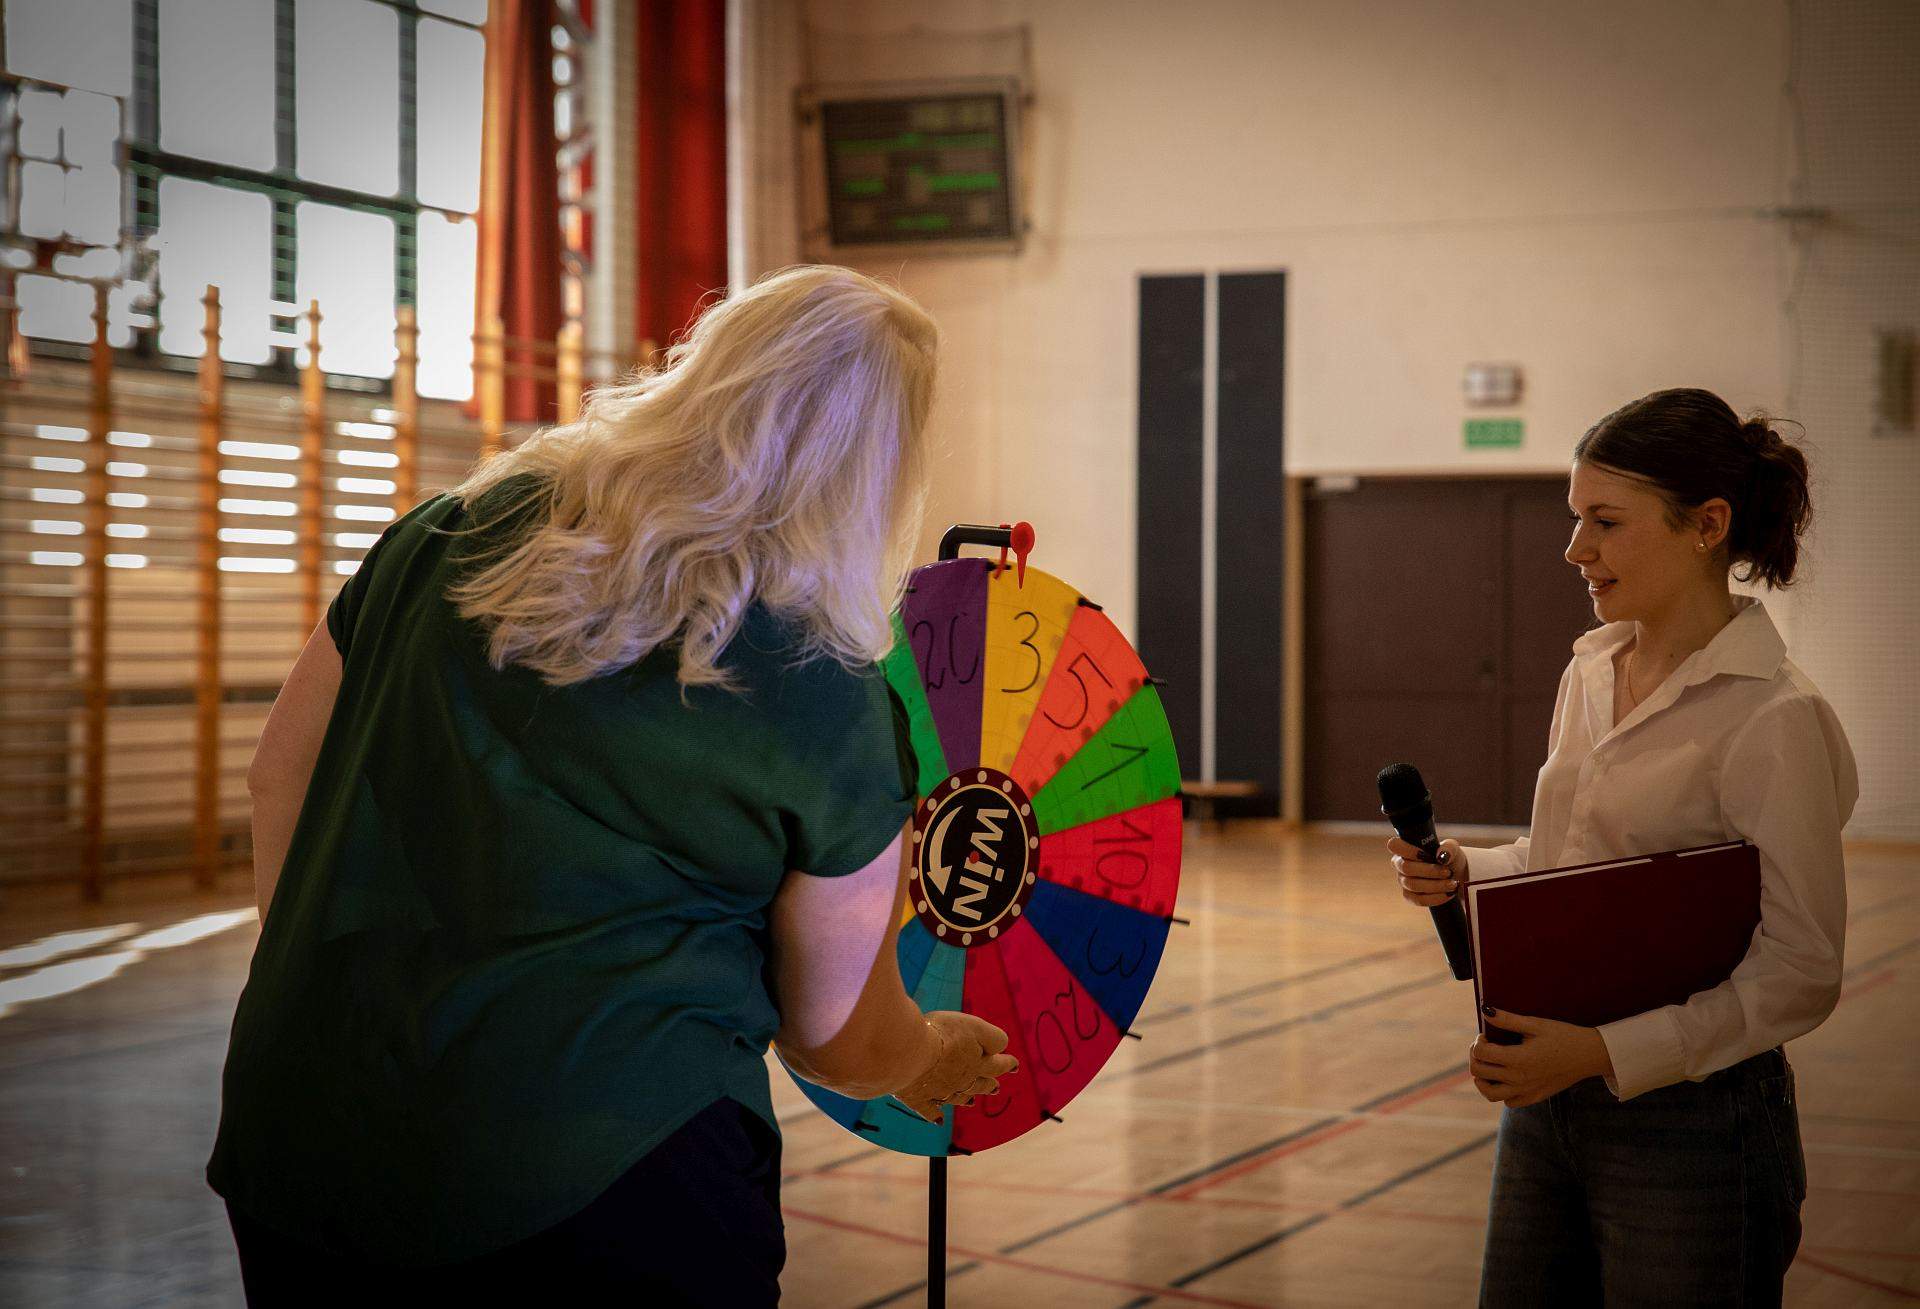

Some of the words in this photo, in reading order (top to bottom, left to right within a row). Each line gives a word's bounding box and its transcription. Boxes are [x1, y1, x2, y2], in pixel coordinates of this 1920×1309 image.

[1001, 611, 1042, 694] 3
[1043, 652, 1114, 730] 5
[1092, 818, 1153, 890] 10
[1086, 926, 1147, 979] 3
[1035, 978, 1102, 1075] 20
